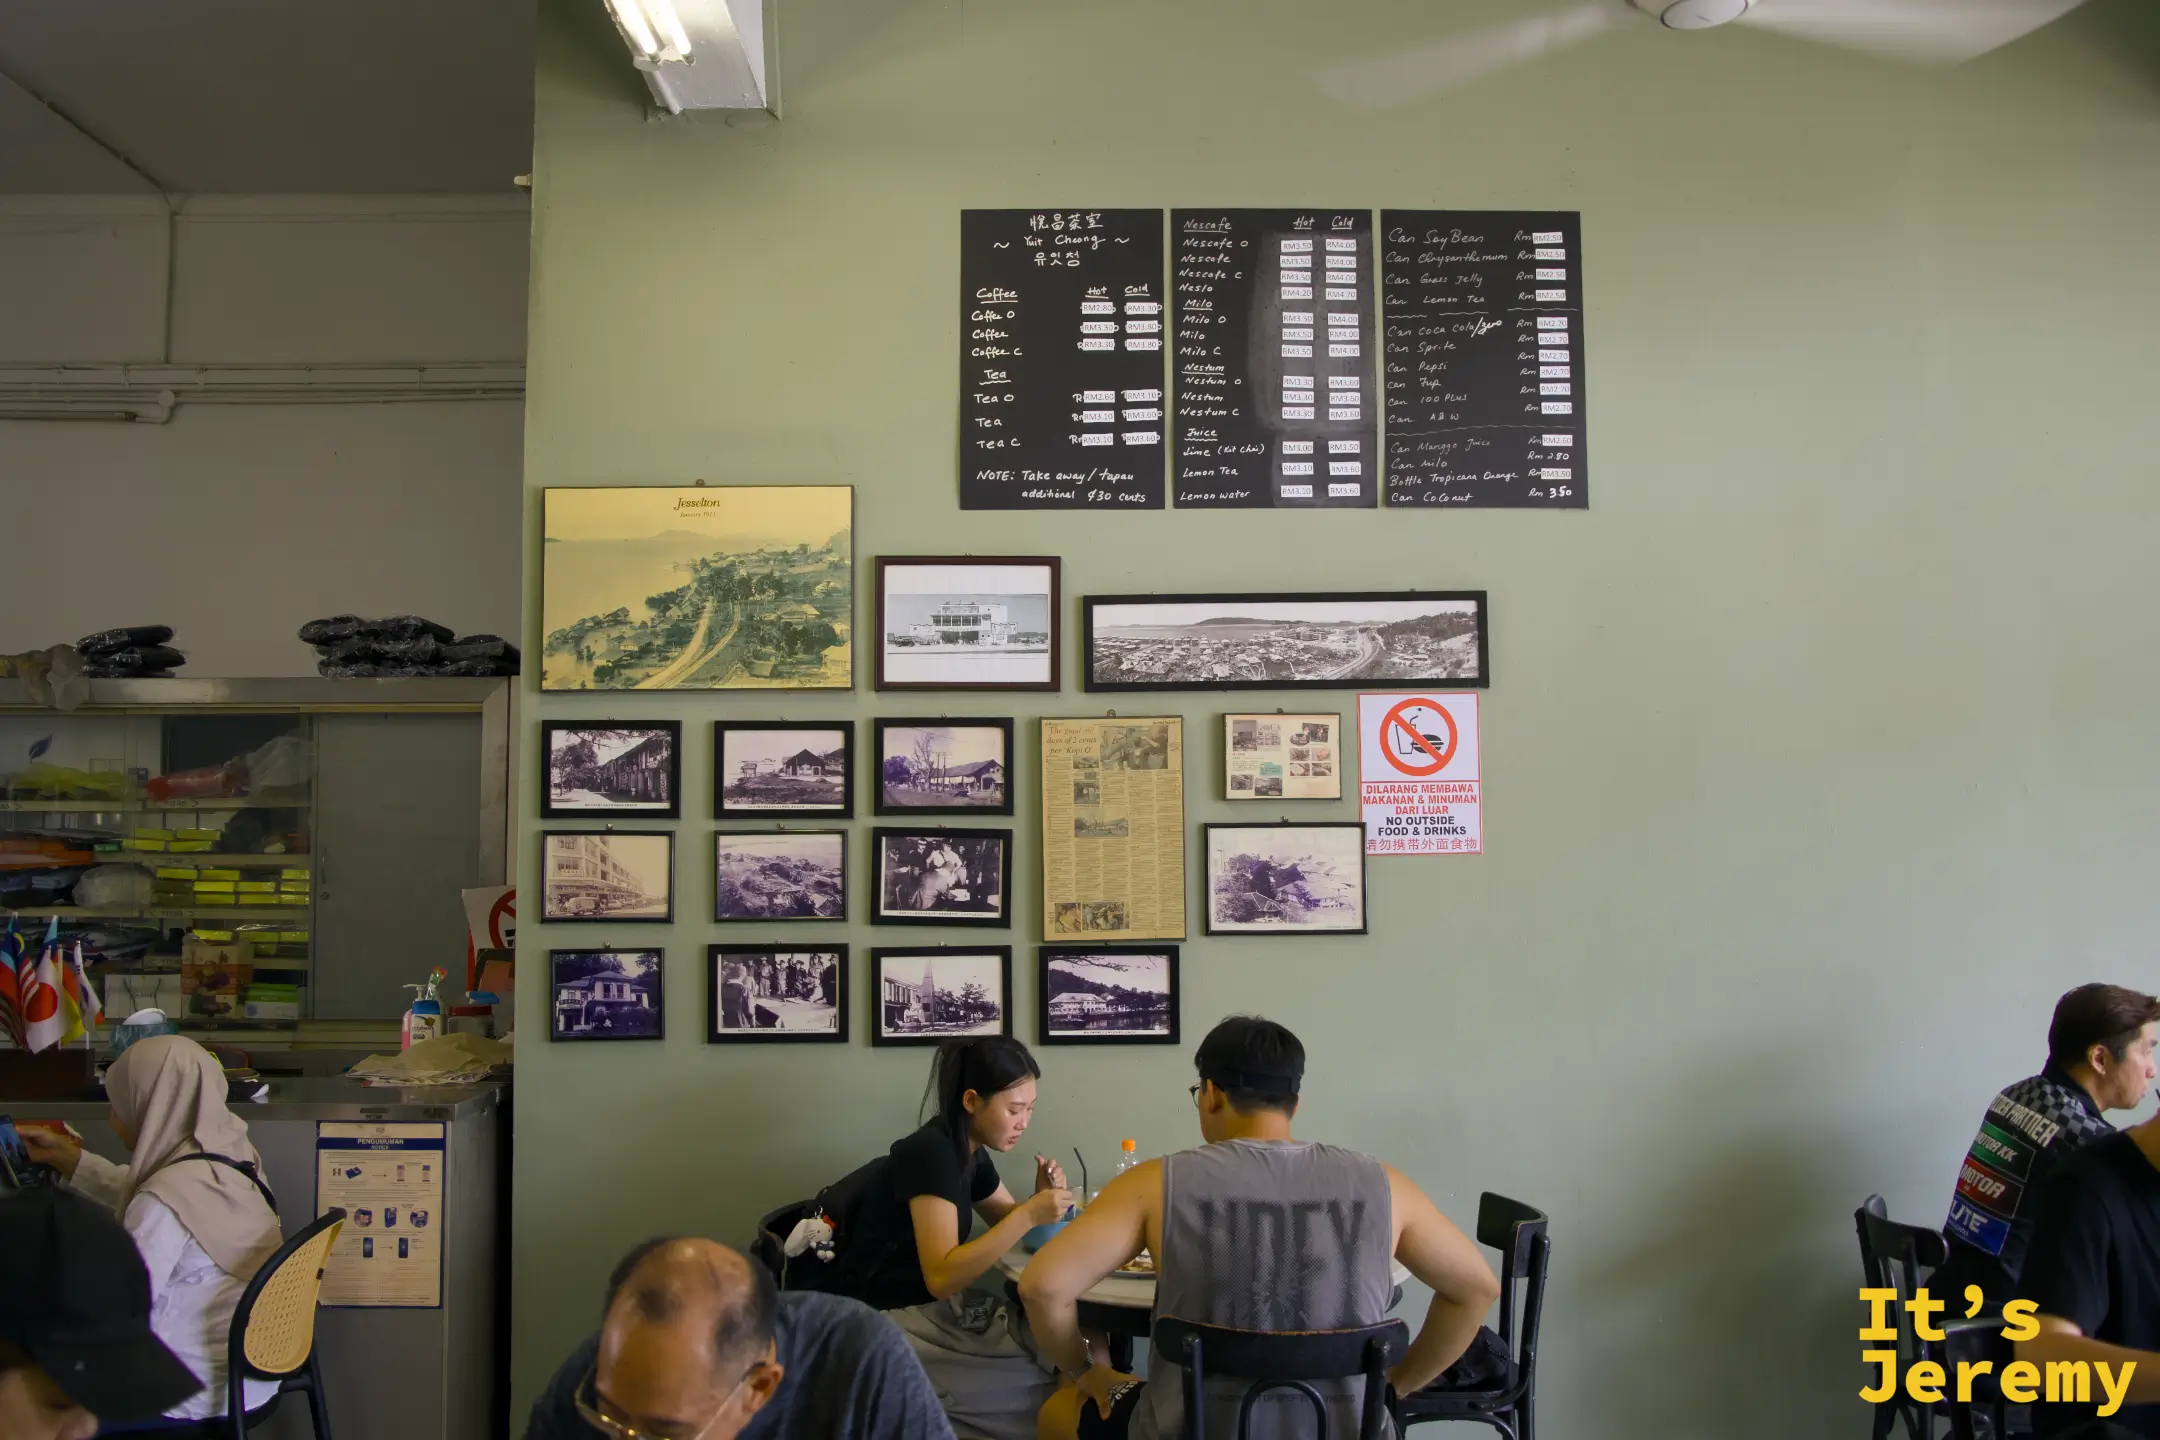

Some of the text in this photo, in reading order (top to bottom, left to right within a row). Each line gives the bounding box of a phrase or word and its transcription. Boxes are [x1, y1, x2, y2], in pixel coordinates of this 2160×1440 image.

[1184, 217, 1232, 230] Nescafe
[1293, 216, 1354, 228] Hot Cold
[1024, 235, 1106, 250] Yuit Cheong
[1182, 237, 1232, 249] Nescafe
[1389, 228, 1484, 250] Can Soy Bean
[1327, 241, 1355, 249] RM4.00
[1180, 254, 1231, 264] Nescafe
[1327, 258, 1355, 266] RM4.00
[1386, 251, 1410, 263] Can
[1178, 269, 1226, 279] Nescafe
[1327, 274, 1355, 282] RM4.00
[1386, 274, 1410, 285] Can
[1455, 274, 1483, 287] Jelly
[1088, 284, 1148, 295] Hot Cold
[1179, 283, 1213, 292] Neslo
[976, 287, 1018, 302] Coffee
[1185, 299, 1212, 308] Milo
[1386, 295, 1408, 305] Can
[1467, 295, 1485, 303] Tea
[1083, 304, 1113, 312] RM2.80
[1182, 314, 1209, 324] Milo
[1329, 316, 1358, 324] RM4.00
[972, 329, 1008, 342] Coffee
[1179, 330, 1205, 340] Milo
[1388, 326, 1411, 337] Can
[1179, 347, 1206, 356] Milo
[1283, 348, 1311, 356] RM3.50
[1387, 341, 1456, 355] Can Sprite
[972, 348, 1010, 359] Coffee
[1184, 363, 1224, 372] Nestum
[1388, 361, 1447, 373] Can Pepsi
[984, 369, 1007, 379] Tea
[1185, 377, 1226, 385] Nestum
[974, 394, 998, 404] Tea
[1085, 392, 1114, 401] RM2.60
[1181, 392, 1224, 401] Nestum
[1420, 395, 1440, 404] 100
[1127, 411, 1157, 419] RM3.60
[1388, 414, 1416, 423] Can
[975, 418, 1002, 428] Tea
[1187, 428, 1218, 436] Juice
[976, 440, 1005, 449] Tea
[1284, 444, 1312, 452] RM3.00
[1330, 443, 1358, 451] RM3.50
[1391, 442, 1410, 454] Can
[1183, 448, 1211, 456] Lime
[1391, 458, 1414, 469] Can
[976, 470, 1015, 480] NOTE:
[1022, 470, 1050, 480] Take
[1183, 467, 1238, 477] Lemon Tea
[1390, 475, 1422, 486] Bottle
[1430, 471, 1477, 485] Tropicana
[1022, 489, 1146, 502] additional cents
[1180, 491, 1216, 501] Lemon
[1330, 487, 1358, 495] RM3.60
[1392, 493, 1413, 502] Can
[673, 498, 721, 510] Jesselton
[1366, 784, 1474, 794] DILARANG MEMBAWA
[1363, 795, 1477, 805] MAKANAN & MINUMAN
[1395, 806, 1448, 815] DARI LUAR
[1386, 816, 1454, 825] NO OUTSIDE
[1378, 826, 1466, 836] FOOD & DRINKS
[2006, 1104, 2060, 1148] PARTNER
